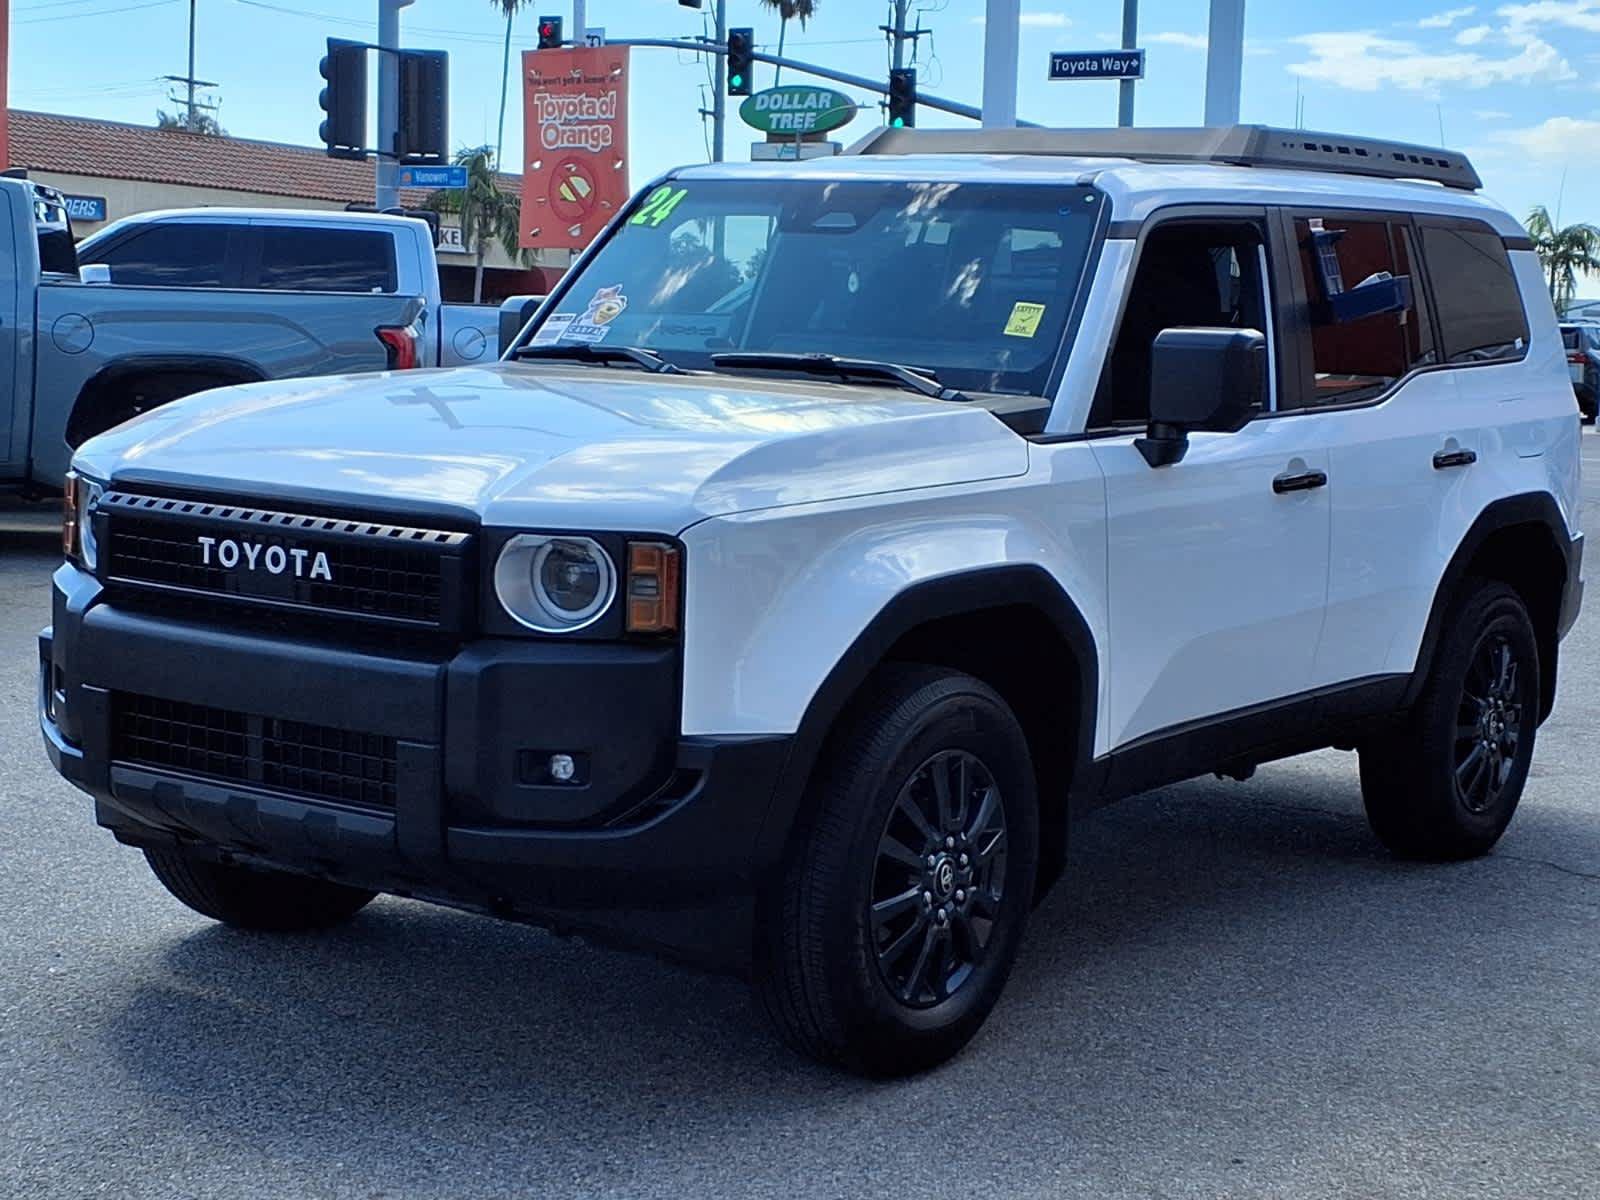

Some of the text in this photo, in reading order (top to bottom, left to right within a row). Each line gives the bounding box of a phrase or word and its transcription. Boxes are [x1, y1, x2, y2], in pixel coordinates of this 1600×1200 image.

[1054, 57, 1129, 74] Toyota Way
[534, 90, 617, 124] Toyota of
[755, 92, 833, 111] DOLLAR
[769, 112, 817, 129] TREE
[541, 120, 612, 152] Orange
[198, 536, 333, 581] TOYOTA
